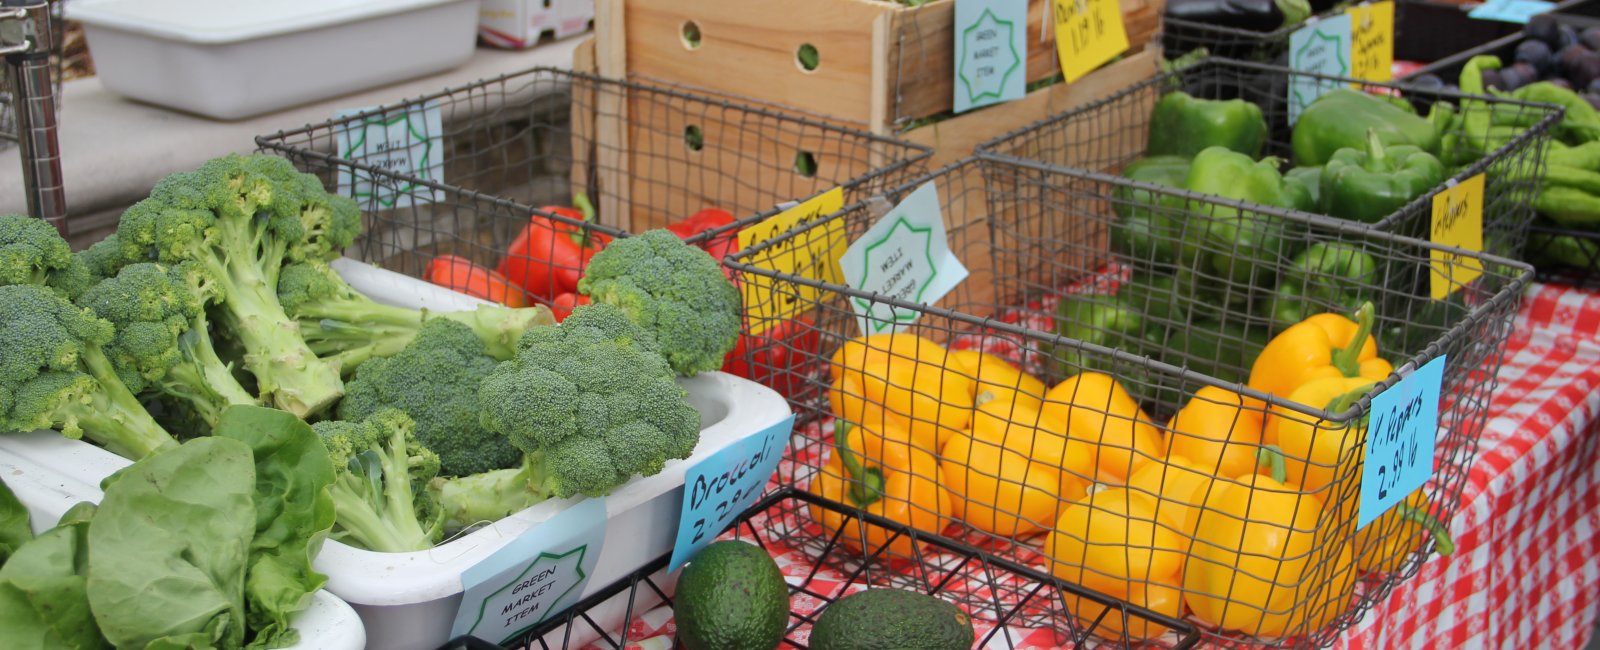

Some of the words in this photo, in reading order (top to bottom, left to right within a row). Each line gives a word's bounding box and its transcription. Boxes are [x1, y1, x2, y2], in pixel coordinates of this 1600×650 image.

[881, 246, 904, 273] ITEM
[881, 258, 914, 296] MARKET
[896, 278, 917, 301] GRE
[1385, 388, 1424, 446] Peppers
[690, 433, 776, 511] Broccoli
[1378, 440, 1405, 501] 2.99
[1408, 427, 1419, 468] lb
[511, 564, 557, 595] GREEN
[501, 580, 557, 616] MARKET
[503, 602, 540, 628] ITEM
